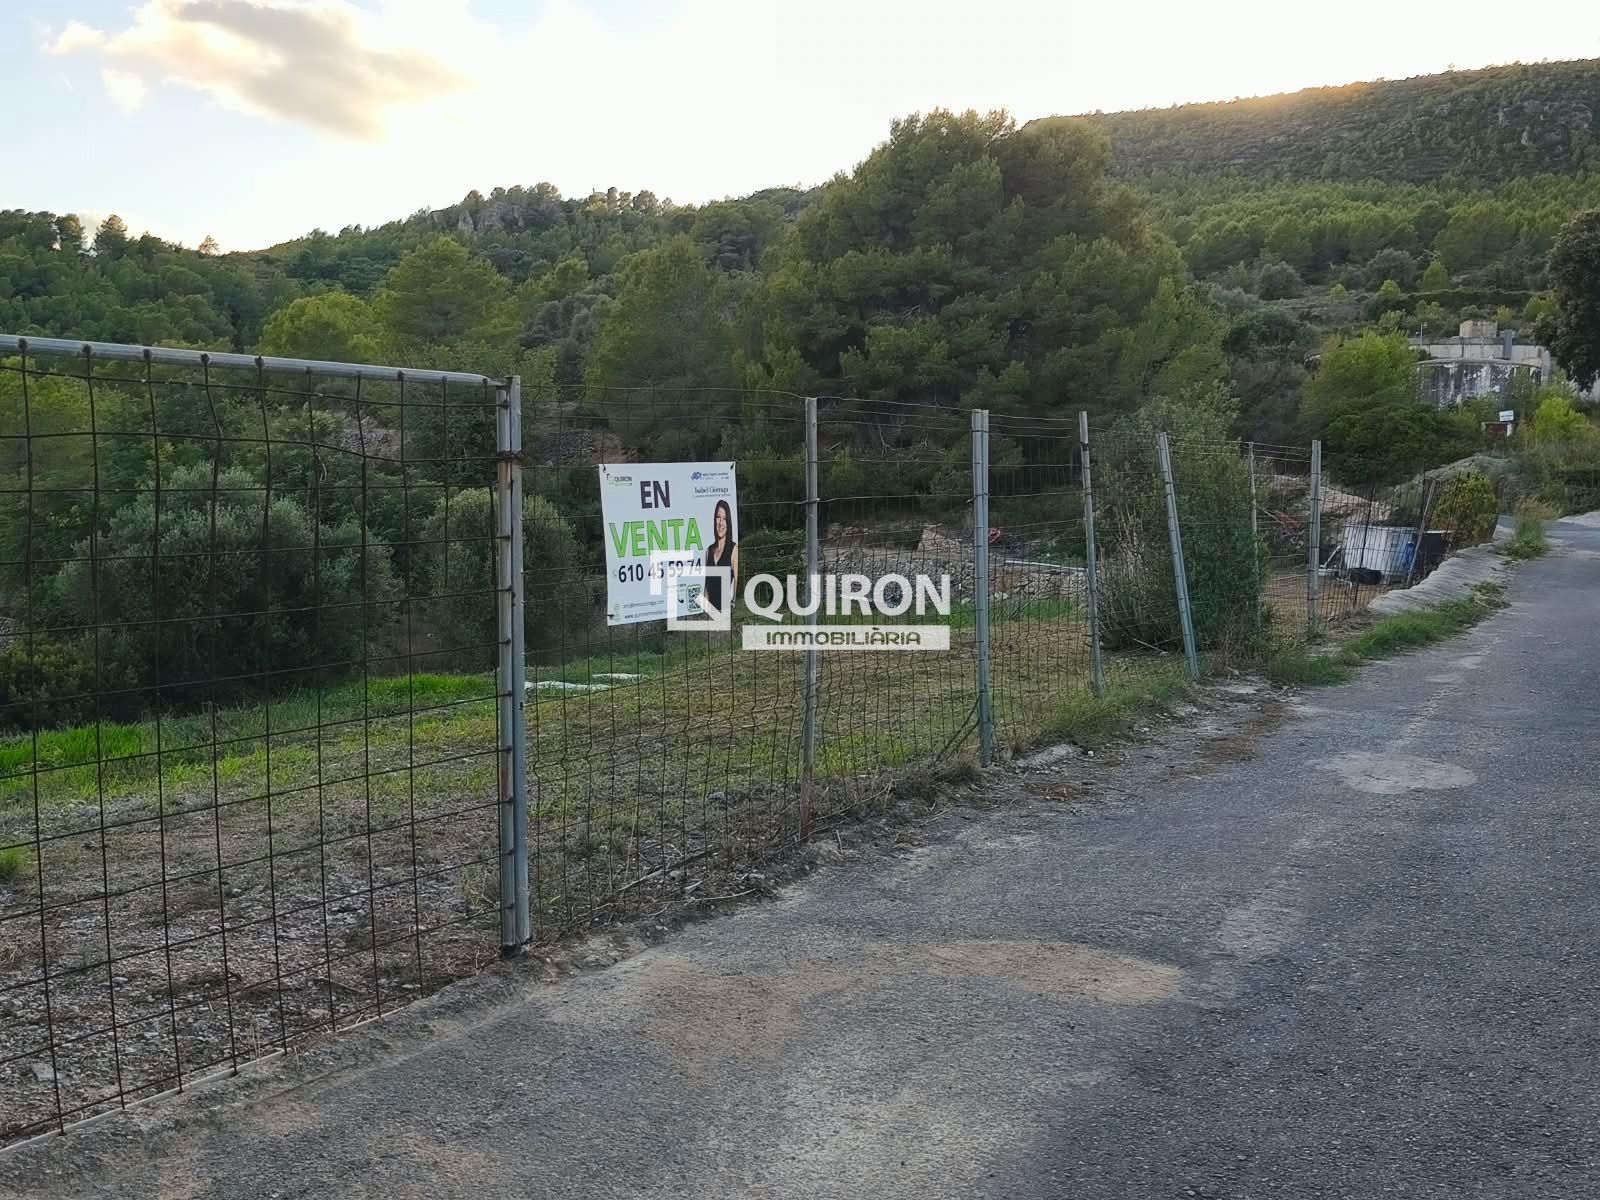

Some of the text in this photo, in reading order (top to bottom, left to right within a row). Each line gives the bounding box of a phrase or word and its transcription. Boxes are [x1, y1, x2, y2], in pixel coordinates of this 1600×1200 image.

[640, 480, 671, 509] EN
[609, 518, 704, 558] VENTA
[618, 557, 702, 583] 610 45 59 74
